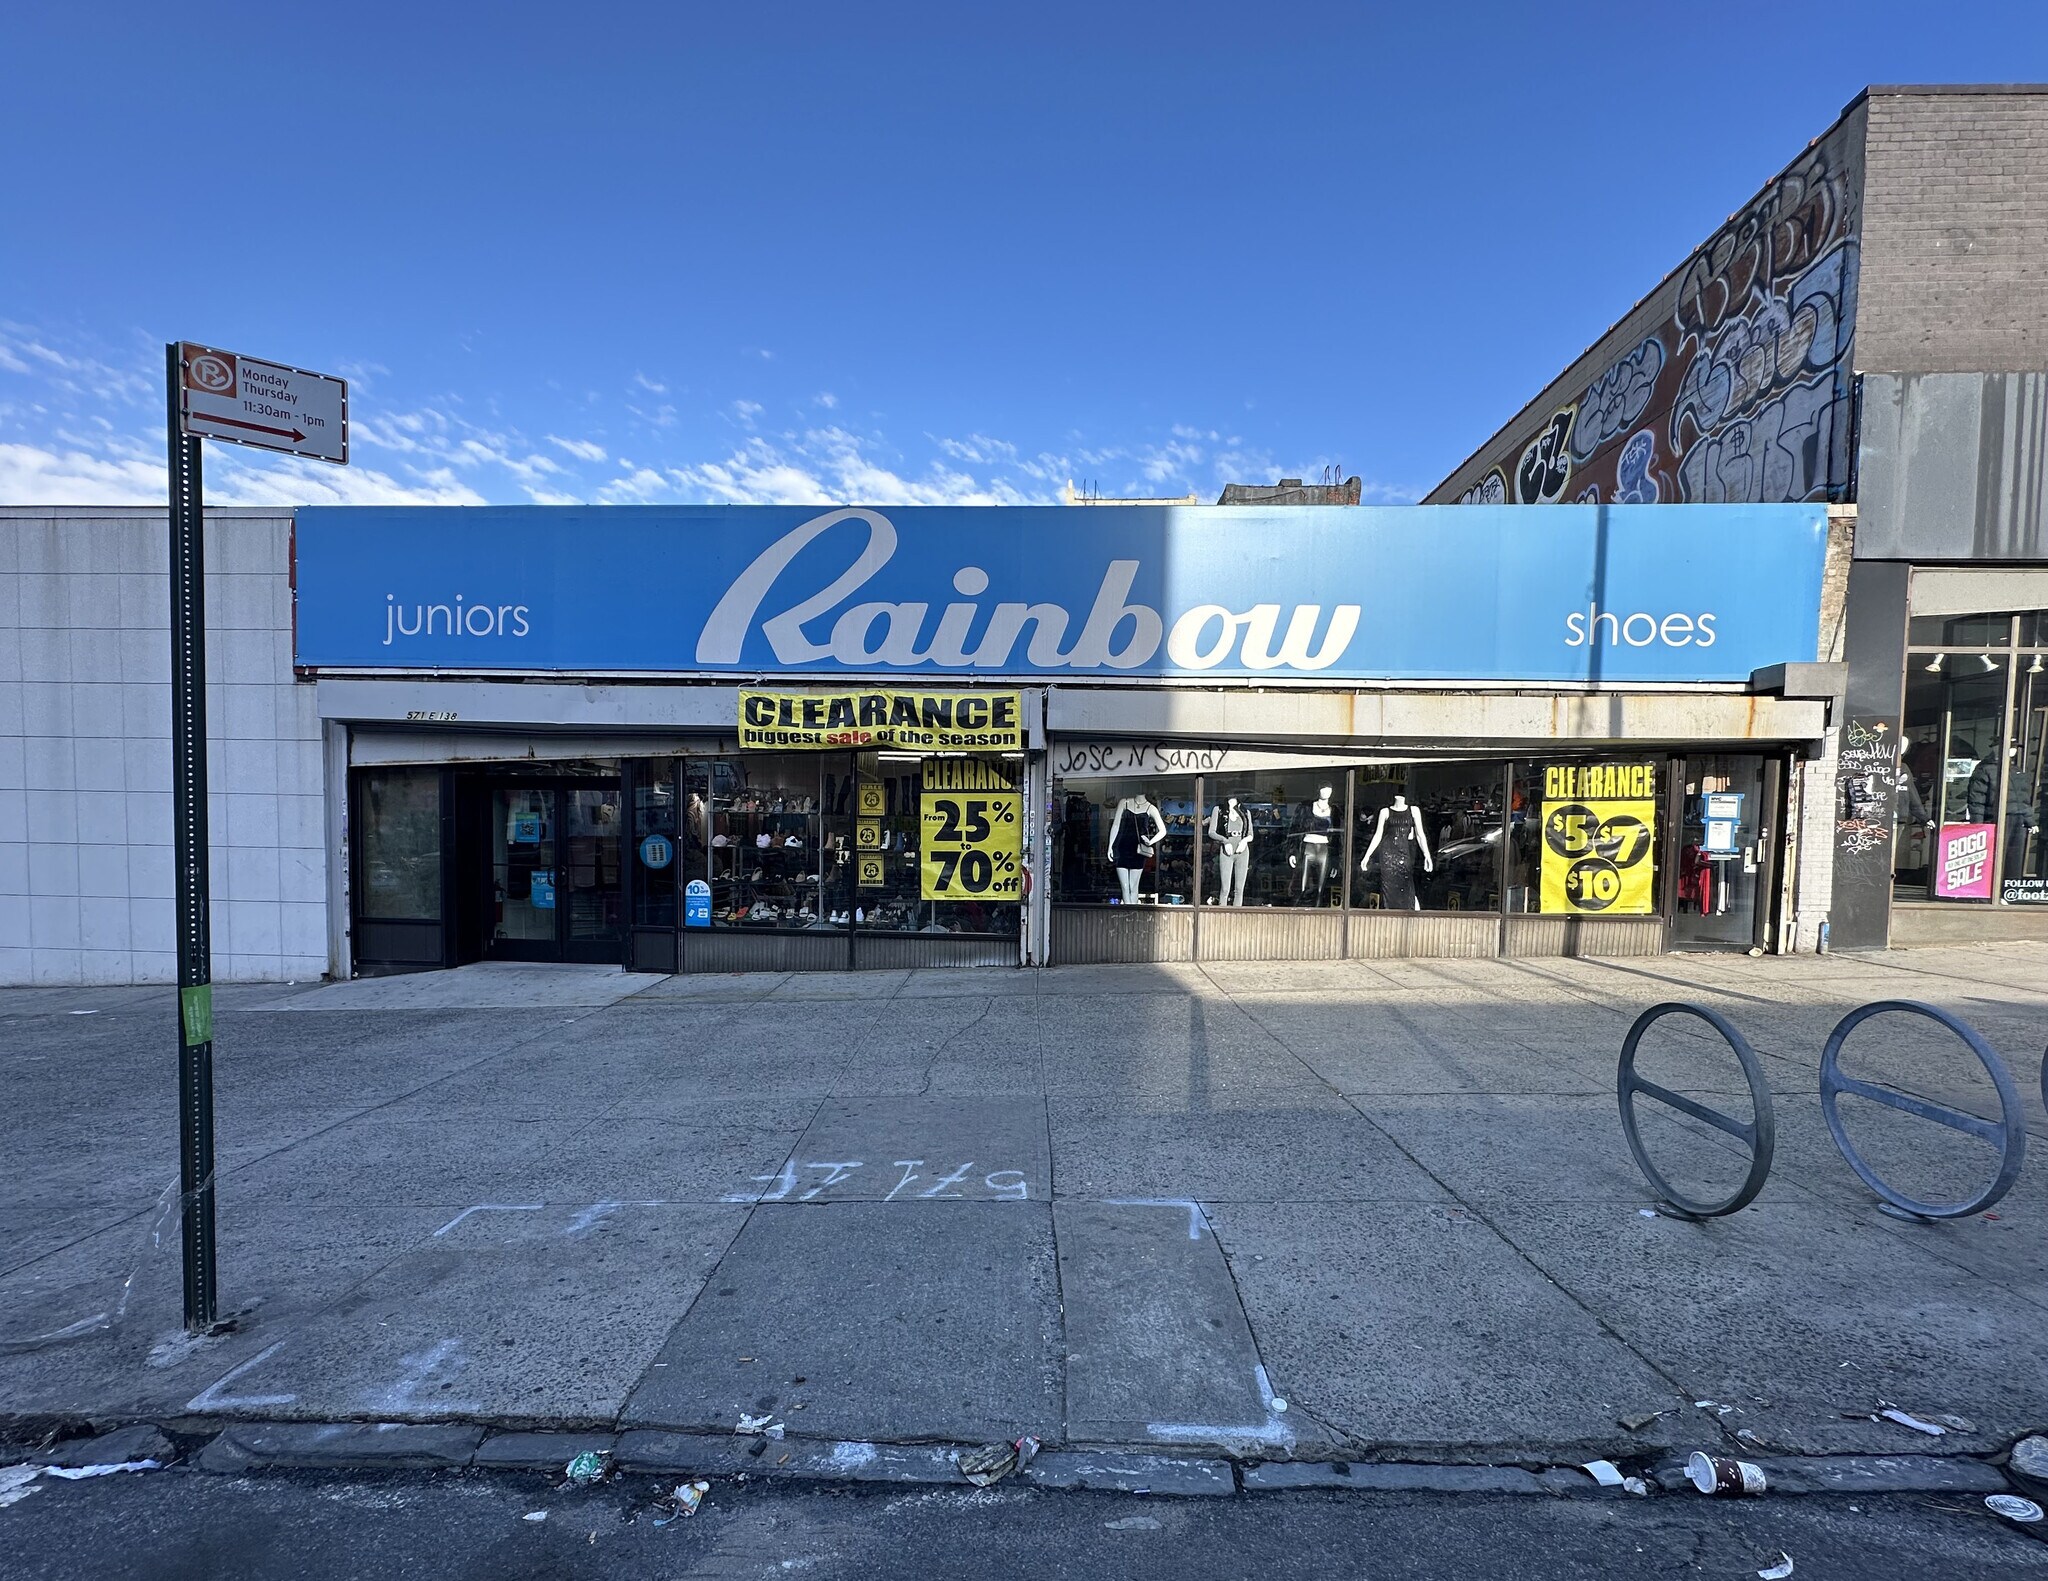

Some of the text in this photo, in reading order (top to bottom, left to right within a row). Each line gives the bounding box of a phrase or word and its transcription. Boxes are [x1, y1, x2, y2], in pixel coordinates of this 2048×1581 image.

[242, 368, 289, 388] Monday
[243, 382, 298, 405] Thursday
[243, 401, 291, 420] 11:30am
[303, 413, 325, 427] 1pm
[695, 508, 1361, 671] Rainbow
[383, 593, 530, 646] juniors
[1565, 602, 1717, 648] shoes
[406, 711, 458, 720] 571 E 138
[744, 694, 1016, 730] CLEARANCE
[744, 728, 1016, 745] biggest sale of the season
[1128, 744, 1149, 767] N
[1545, 766, 1654, 798] CLEARANCE
[934, 800, 1014, 842] 25%
[961, 842, 972, 850] to
[1553, 814, 1641, 862] $5 $7
[1948, 831, 1987, 860] BOGO
[930, 850, 1015, 893] 70%
[992, 877, 1018, 892] off
[1567, 869, 1620, 900] $10
[1947, 862, 1984, 891] SALE
[2005, 880, 2043, 888] FOLLOW
